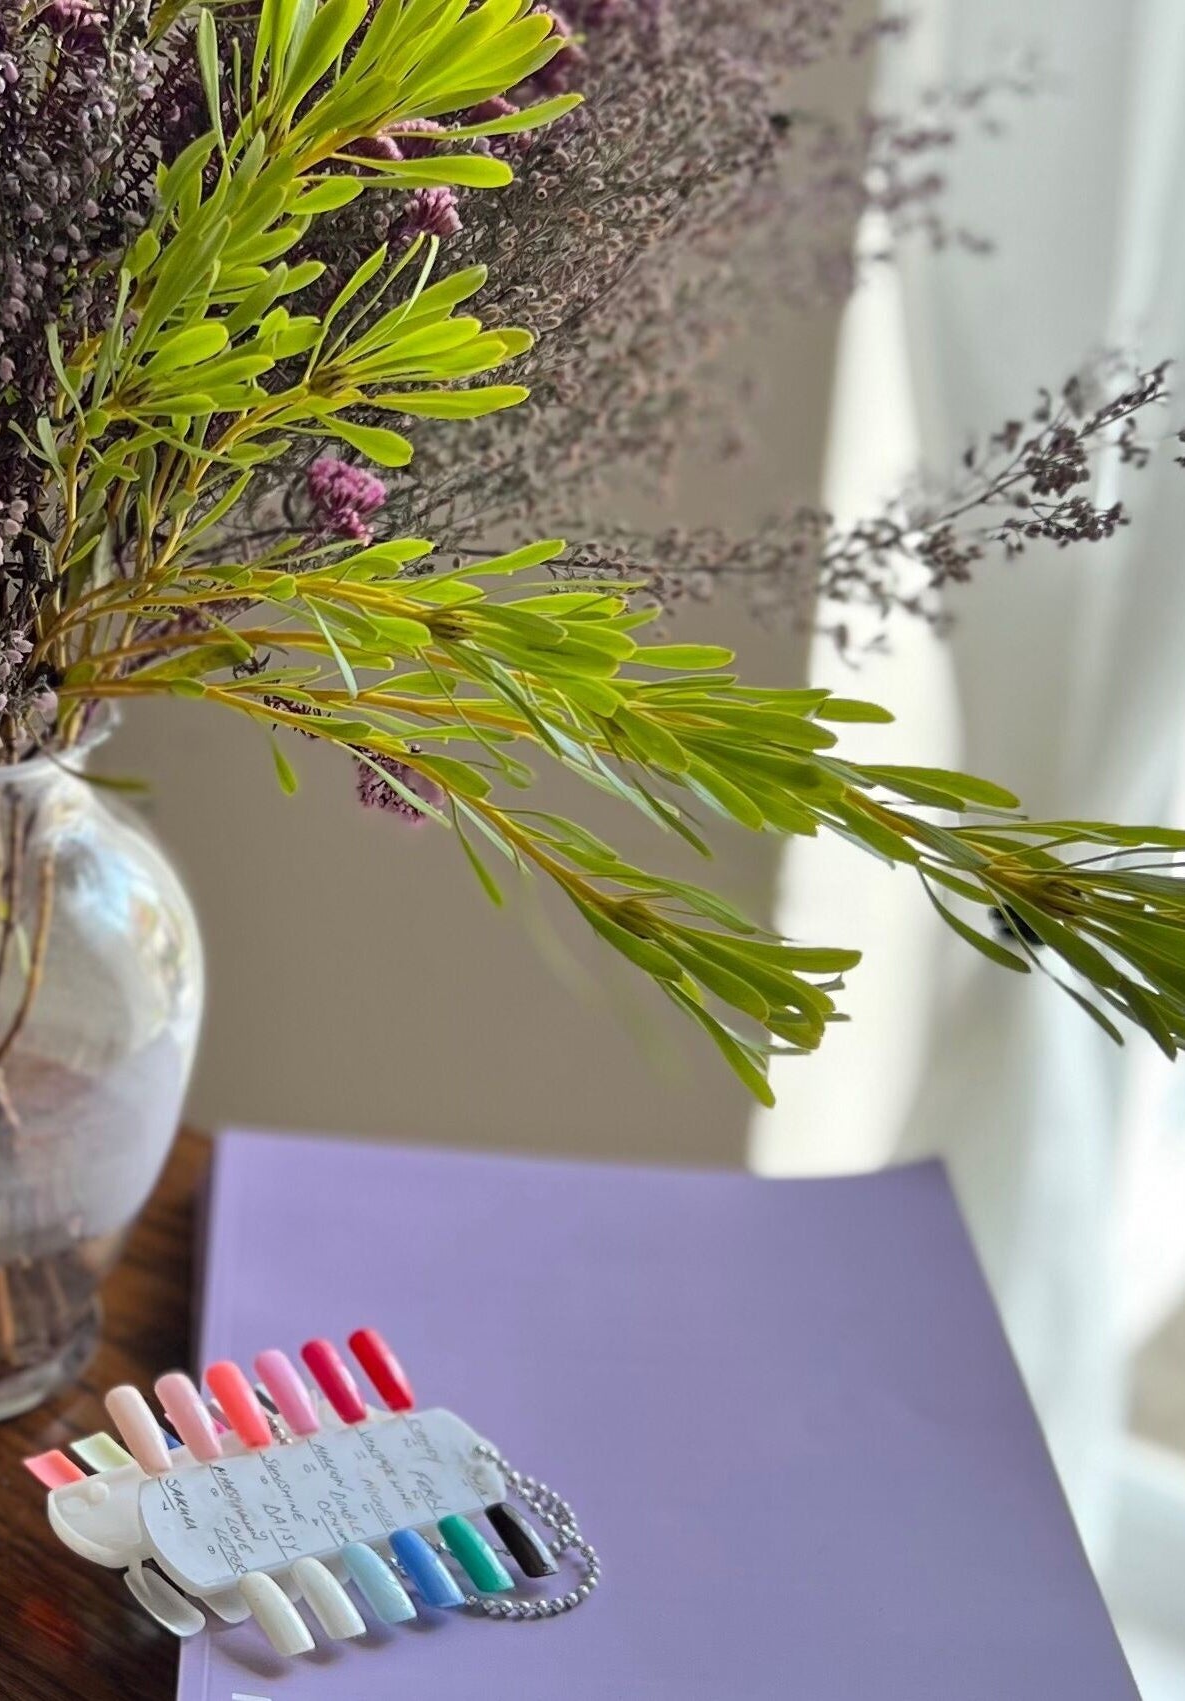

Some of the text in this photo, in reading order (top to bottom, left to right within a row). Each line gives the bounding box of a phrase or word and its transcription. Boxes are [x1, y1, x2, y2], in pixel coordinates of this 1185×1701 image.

[262, 1455, 308, 1524] SUNSHINE
[303, 1463, 317, 1474] 10
[225, 1517, 254, 1554] LOVE
[262, 1503, 302, 1551] DAISY
[329, 1491, 367, 1536] DOUBLE
[213, 1528, 247, 1574] LETTER
